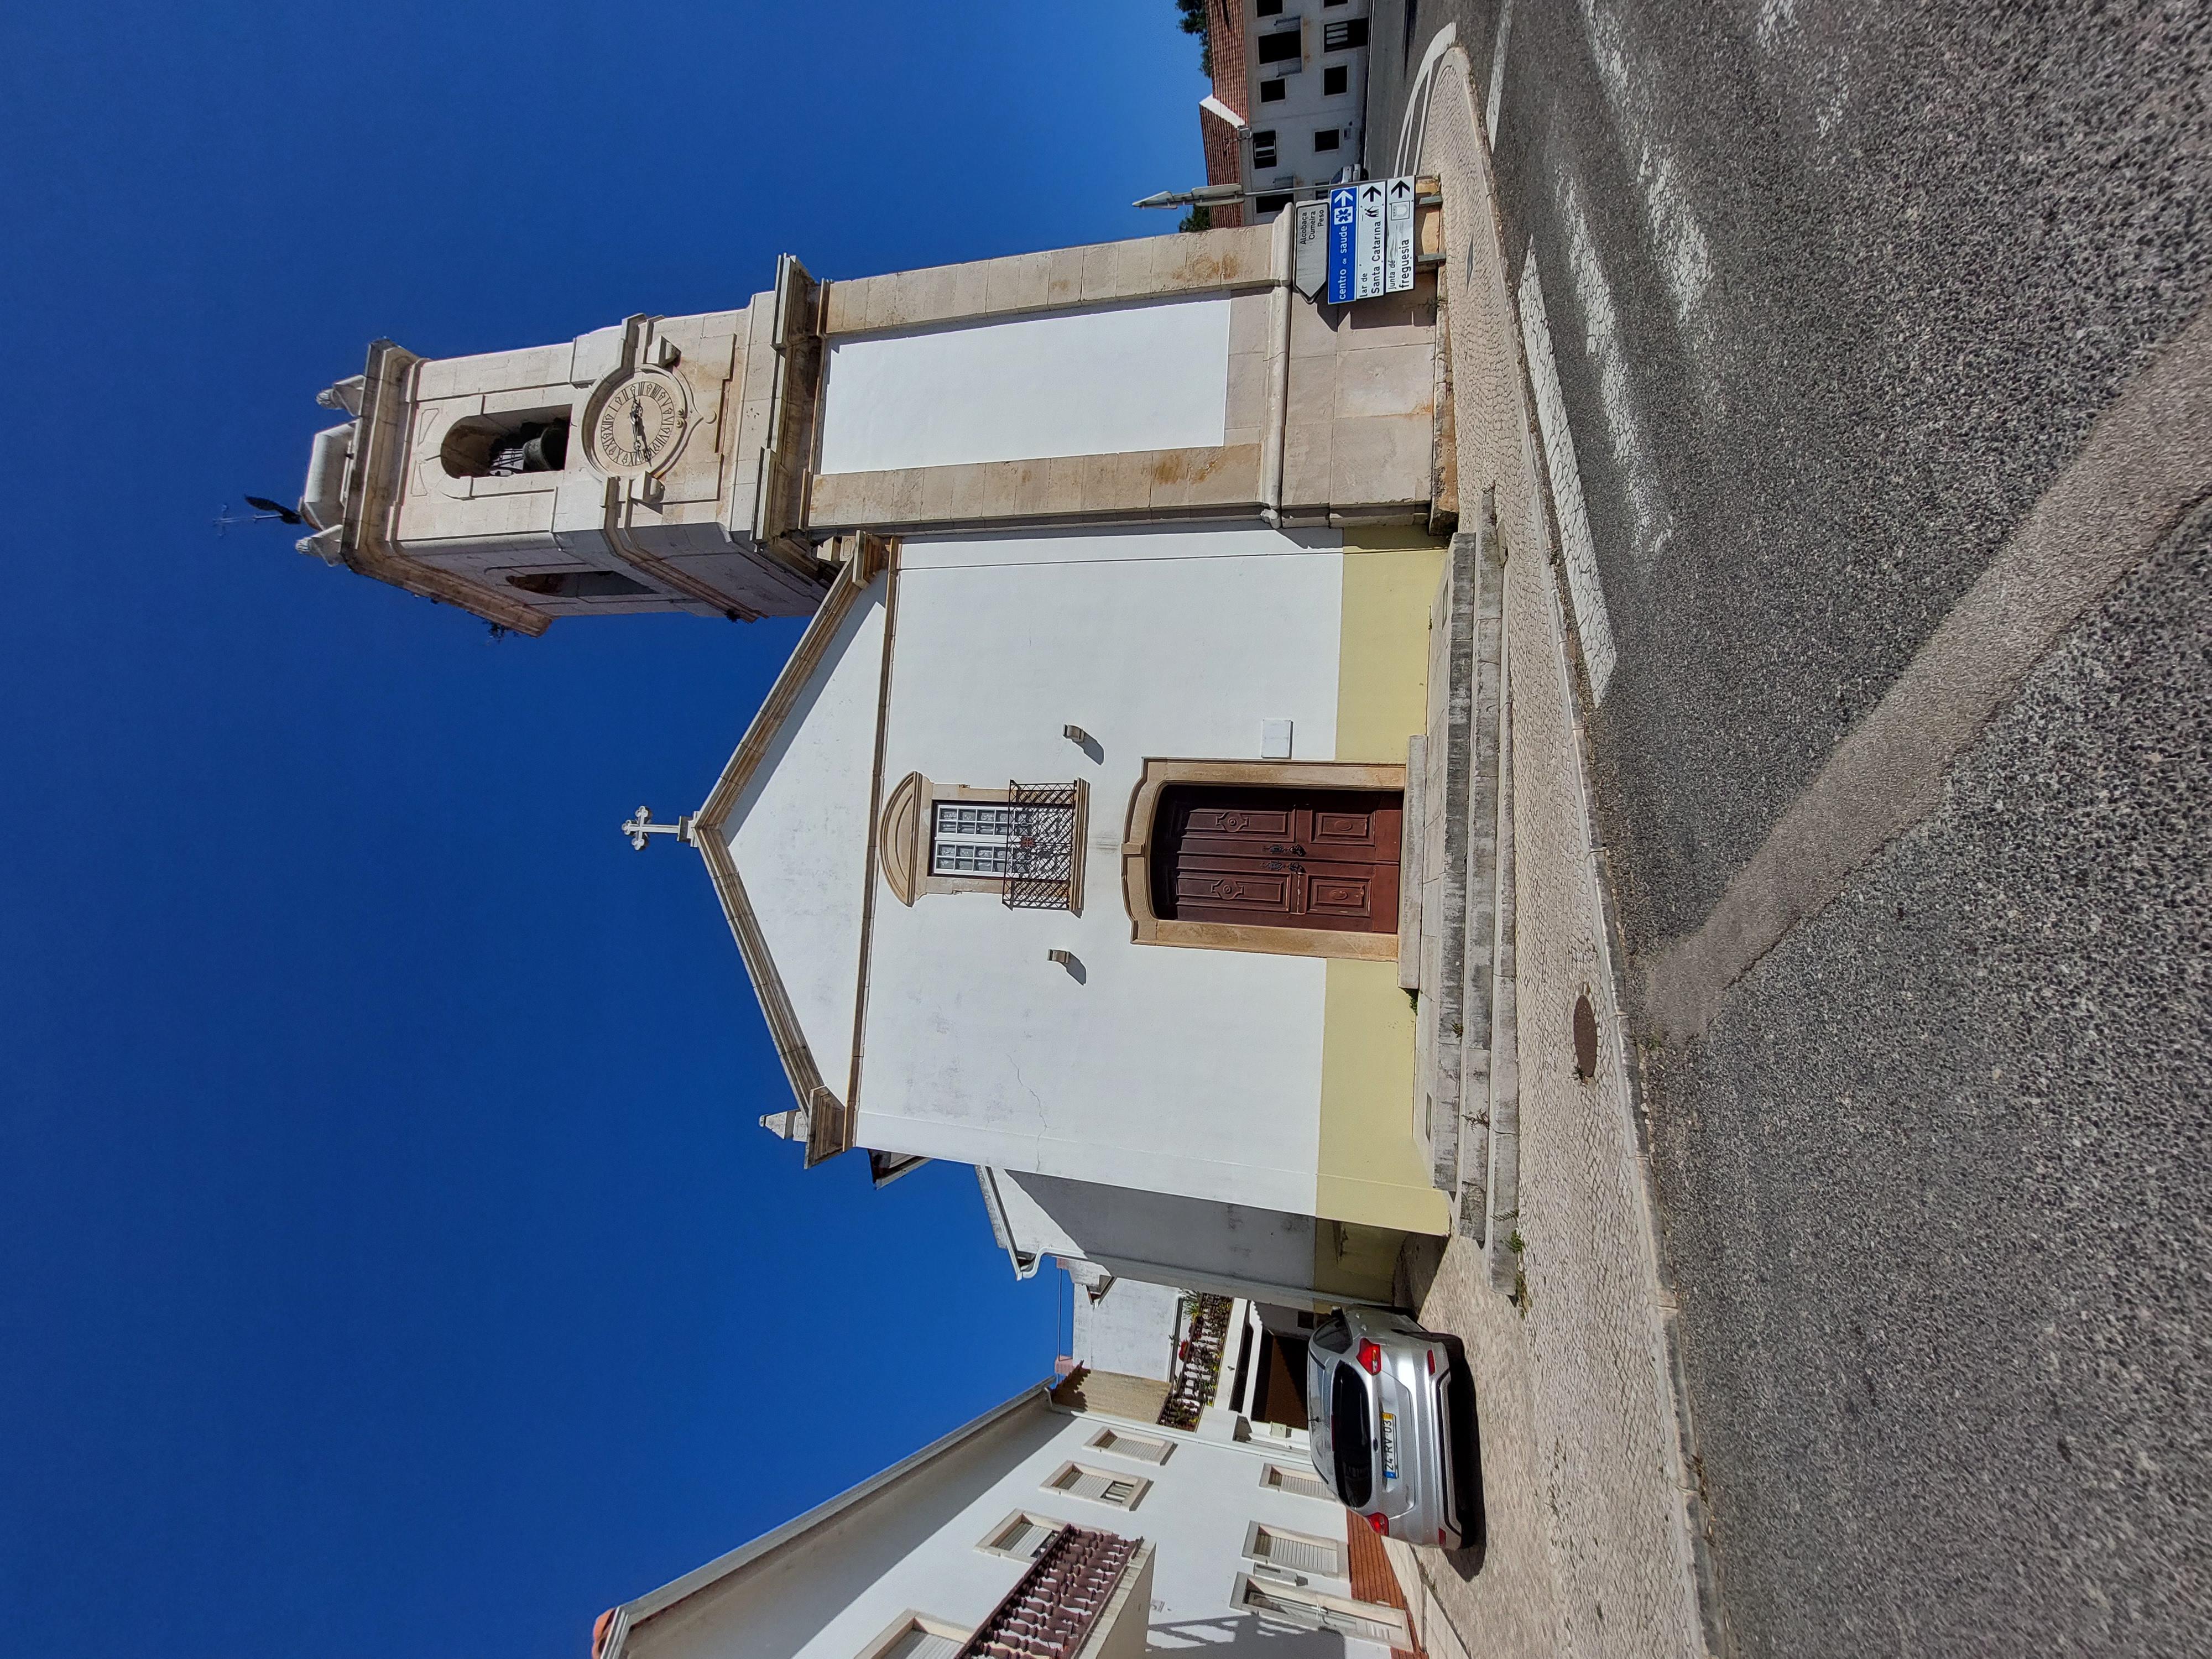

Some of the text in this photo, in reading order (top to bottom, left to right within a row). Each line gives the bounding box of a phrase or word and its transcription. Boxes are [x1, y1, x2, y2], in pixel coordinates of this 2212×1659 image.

[1300, 212, 1308, 244] Alcobaça
[1339, 226, 1347, 253] saude
[1371, 221, 1381, 294] Santa Catarina
[1399, 239, 1411, 289] freguesia
[1337, 269, 1347, 300] centro
[1360, 273, 1368, 282] de
